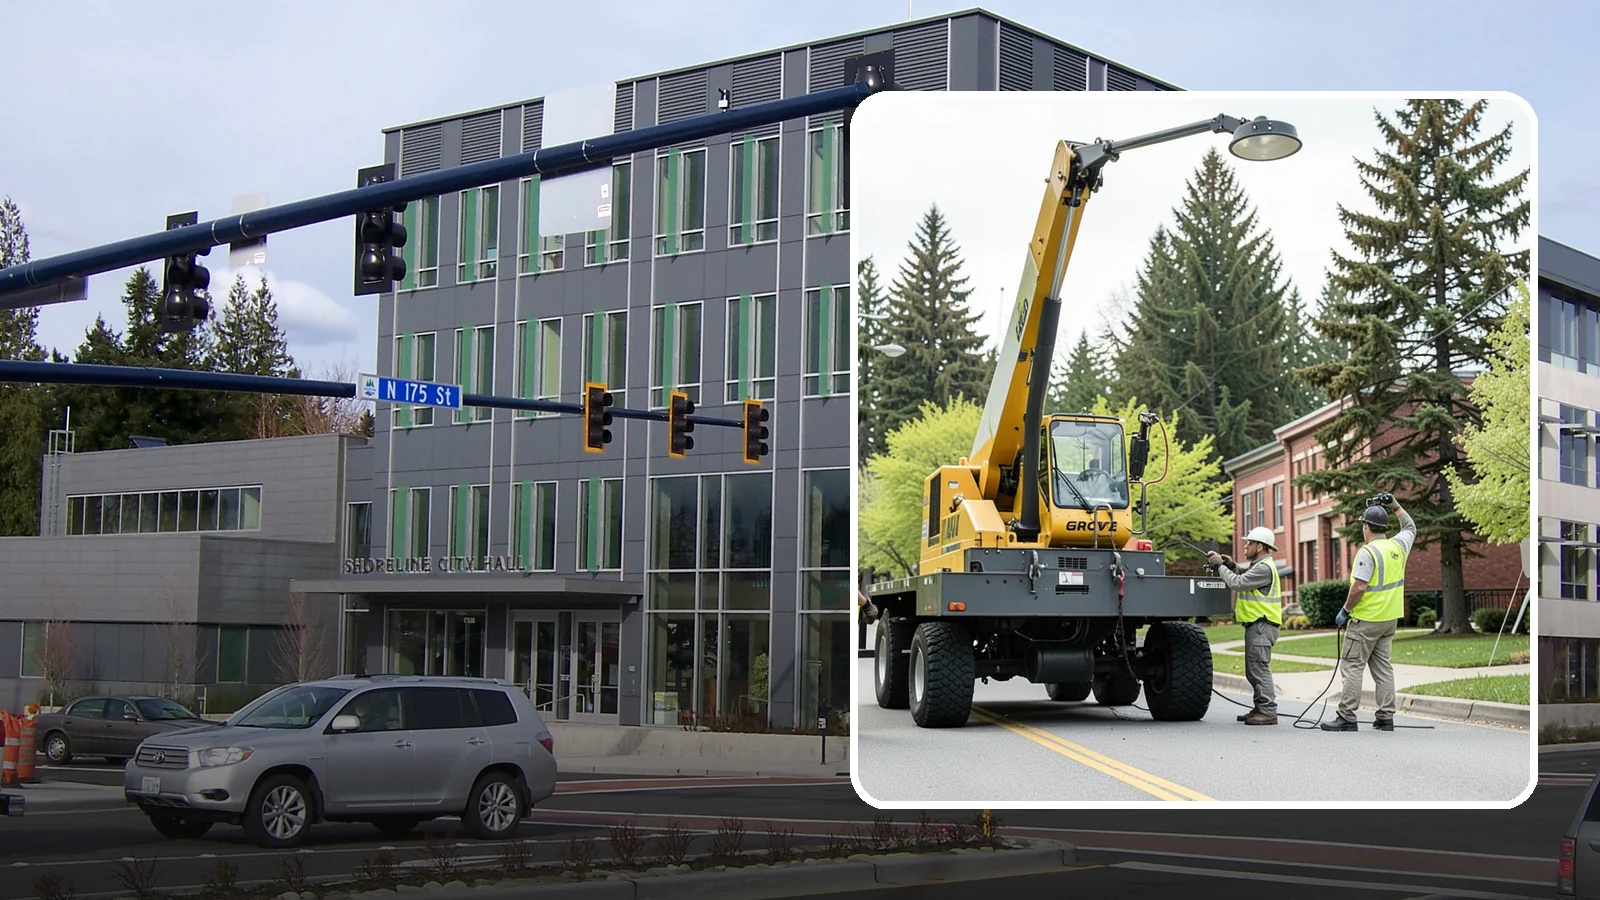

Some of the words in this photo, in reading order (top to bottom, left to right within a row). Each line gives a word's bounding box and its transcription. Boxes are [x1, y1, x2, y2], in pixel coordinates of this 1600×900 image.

[387, 380, 396, 400] N
[405, 382, 427, 403] 175
[436, 386, 451, 406] St
[1066, 520, 1118, 532] GROVE
[343, 556, 432, 574] SHORELINE
[438, 556, 475, 572] CITY
[484, 555, 525, 571] HALL
